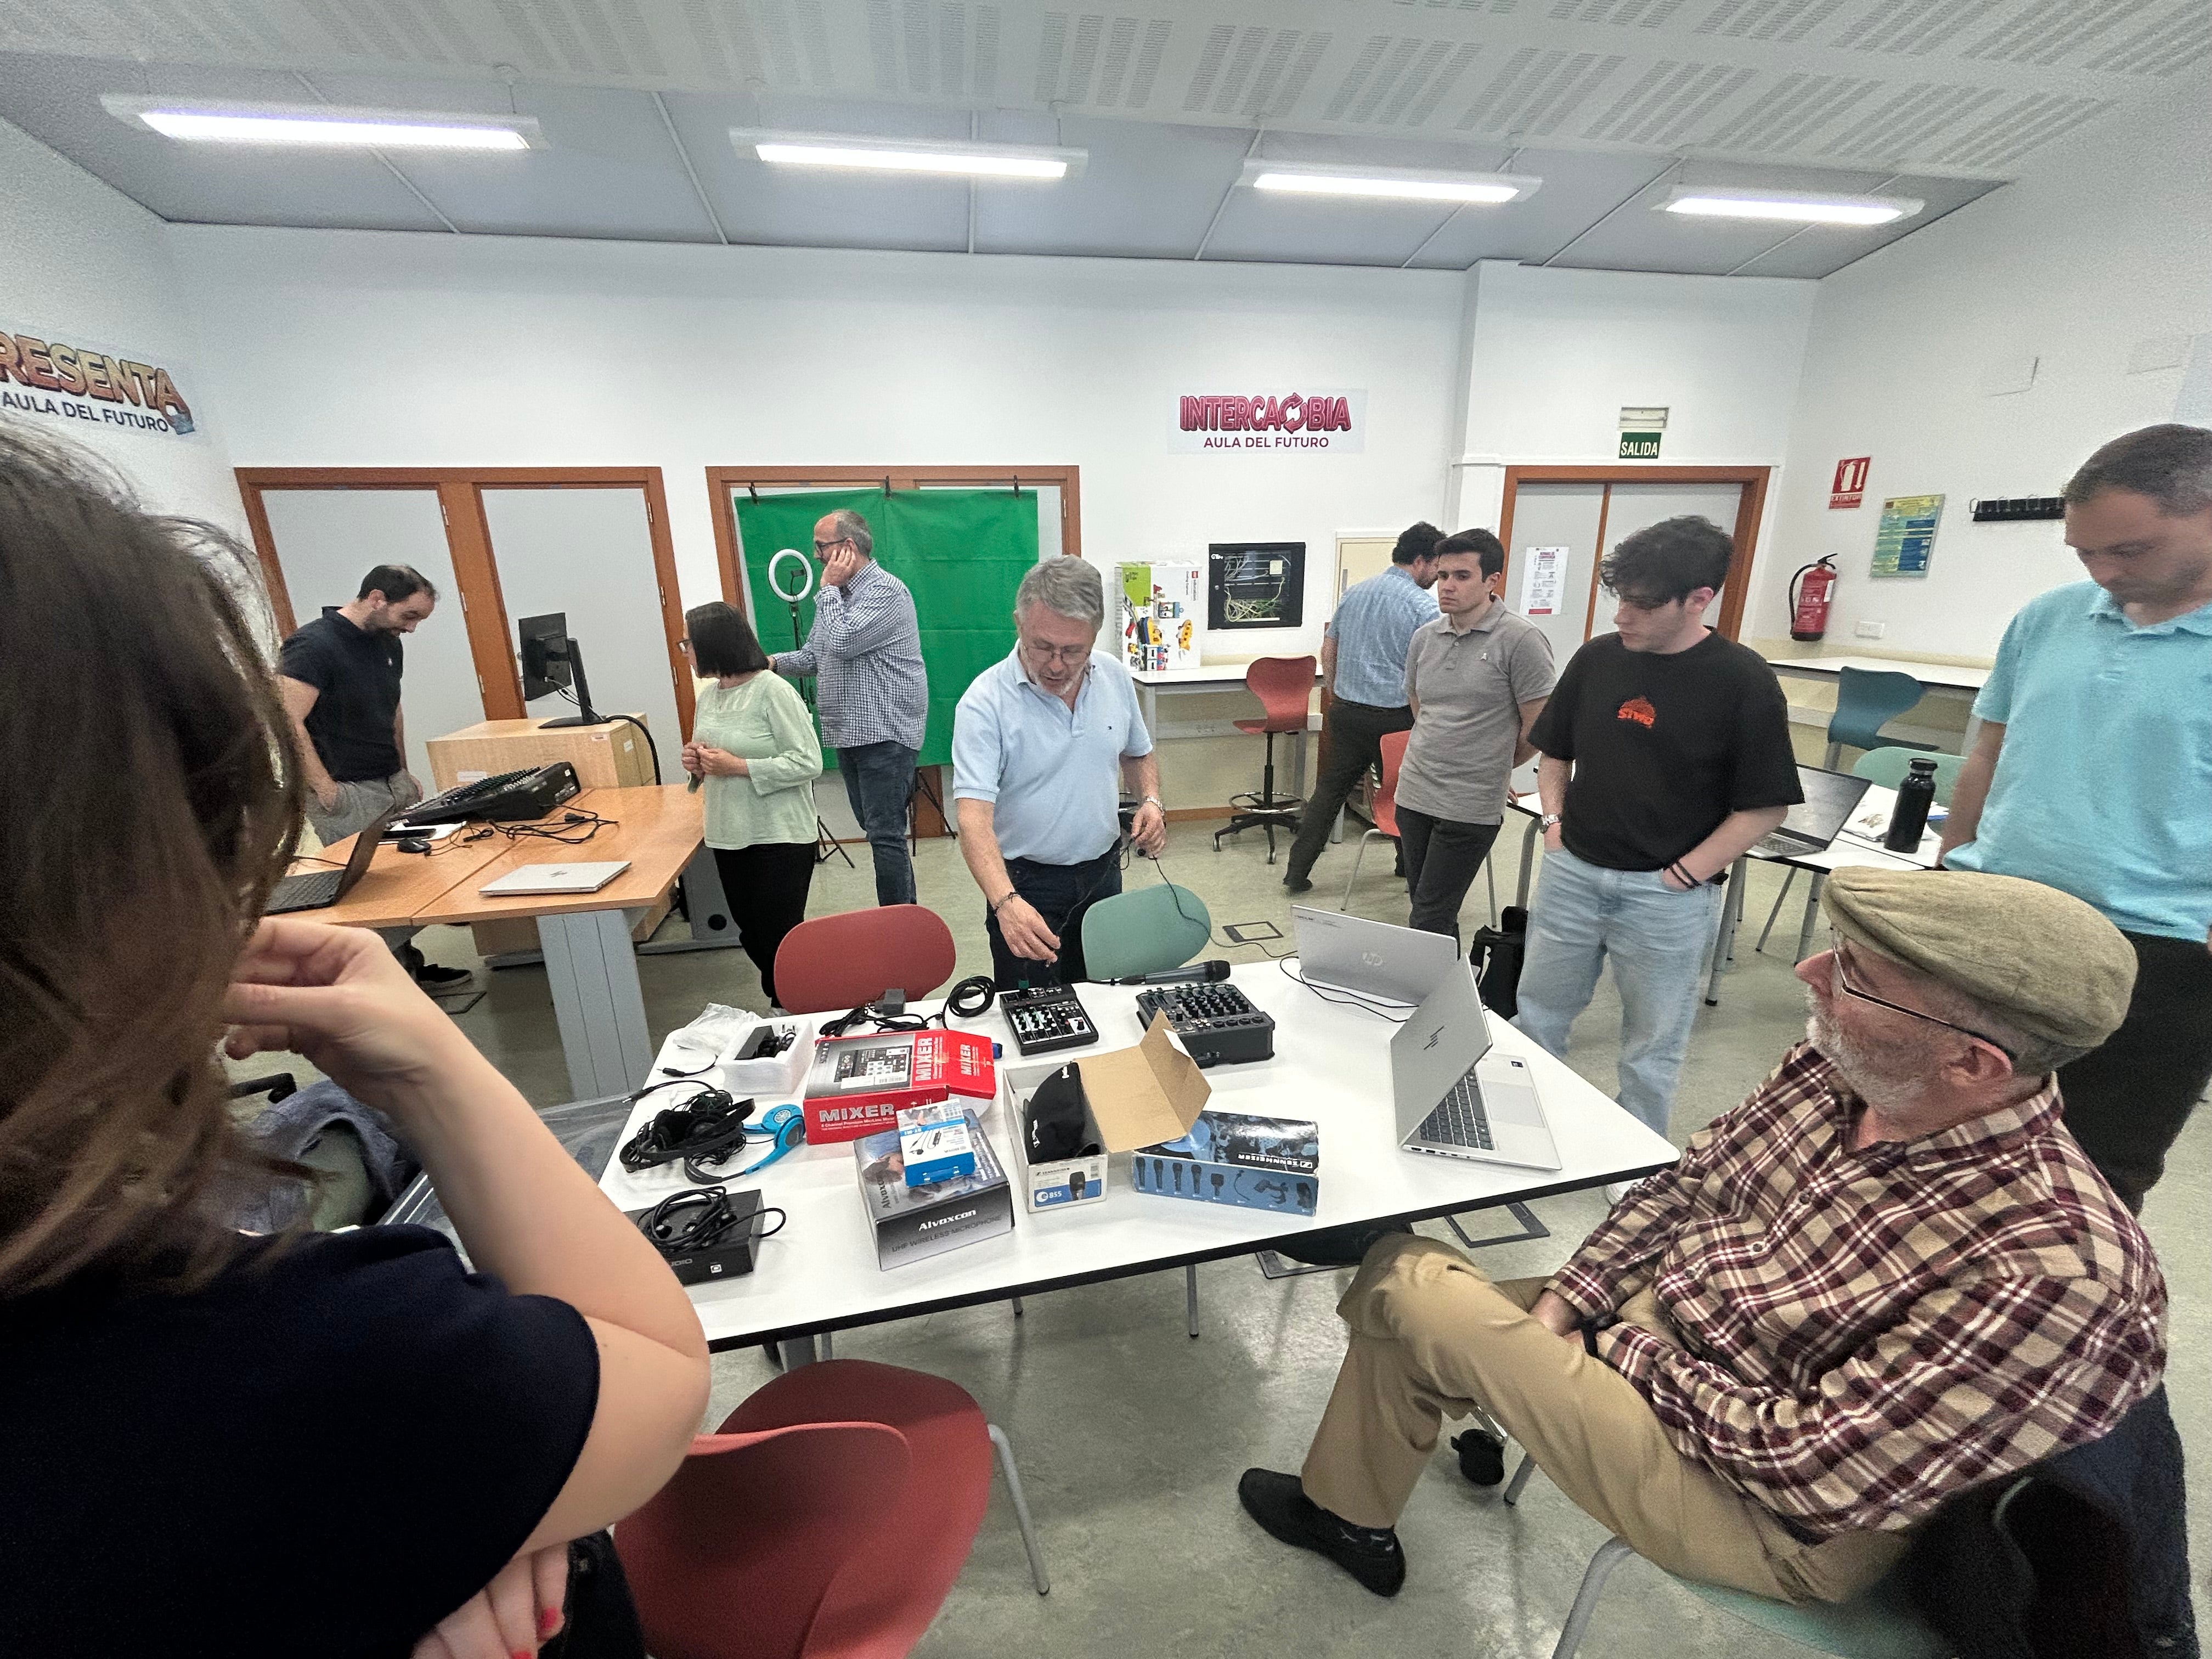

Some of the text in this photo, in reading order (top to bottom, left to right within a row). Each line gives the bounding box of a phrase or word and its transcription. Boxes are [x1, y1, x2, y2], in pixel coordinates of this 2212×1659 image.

[3, 392, 169, 432] AULA DEL FUTURO
[1204, 437, 1329, 448] AULA DEL FUTURO
[1621, 442, 1657, 456] SALIDA
[915, 1037, 933, 1081] MIXER
[960, 1044, 972, 1076] MIXER
[819, 1103, 895, 1122] MIXER
[1238, 1154, 1297, 1166] SENNHEISER
[1049, 1190, 1062, 1199] 855
[918, 1209, 977, 1232] Alvoxcon
[891, 1215, 1002, 1252] UHF WIRELESS MICROPHONE
